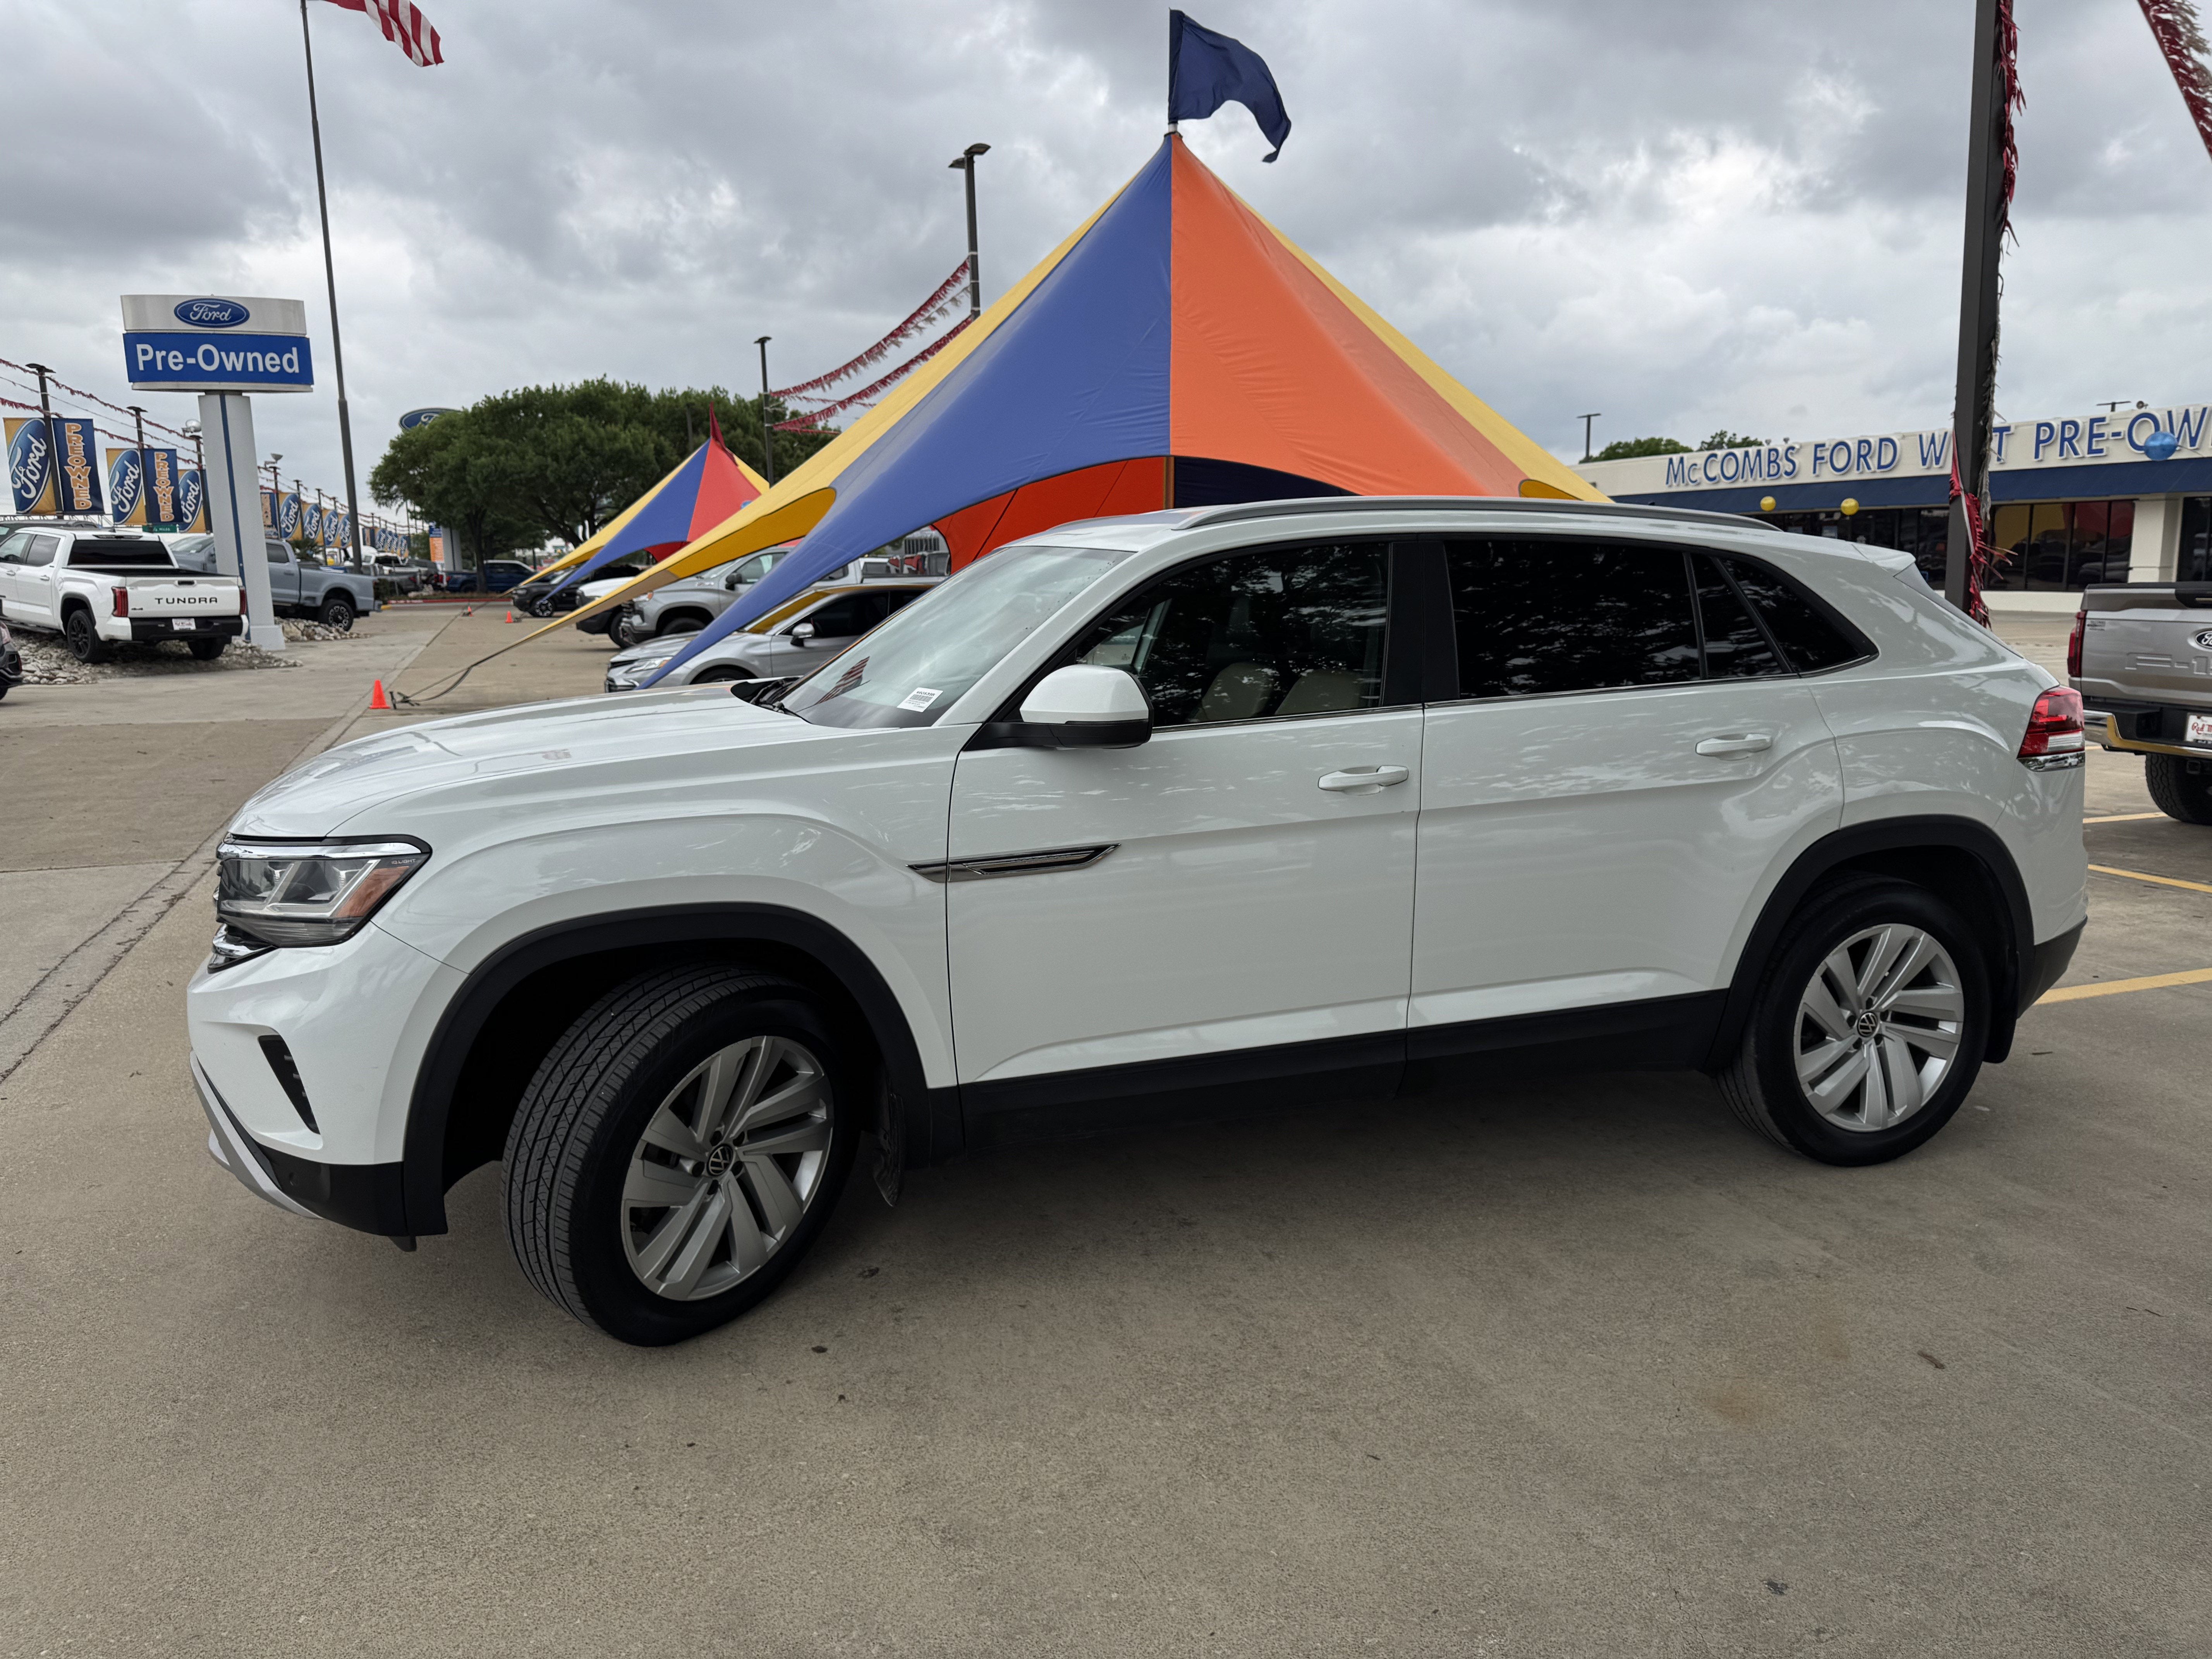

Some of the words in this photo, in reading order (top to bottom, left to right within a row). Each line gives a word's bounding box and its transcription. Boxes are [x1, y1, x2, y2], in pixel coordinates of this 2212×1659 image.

[189, 303, 232, 321] Ford
[136, 343, 300, 373] Pre-Owned
[1812, 437, 1897, 475] FORD
[1918, 426, 2011, 466] WT
[2034, 407, 2212, 460] PRE-OW
[10, 433, 47, 499] Ford
[110, 460, 140, 513] Ford
[280, 500, 299, 533] Ford
[304, 509, 320, 539] Ford
